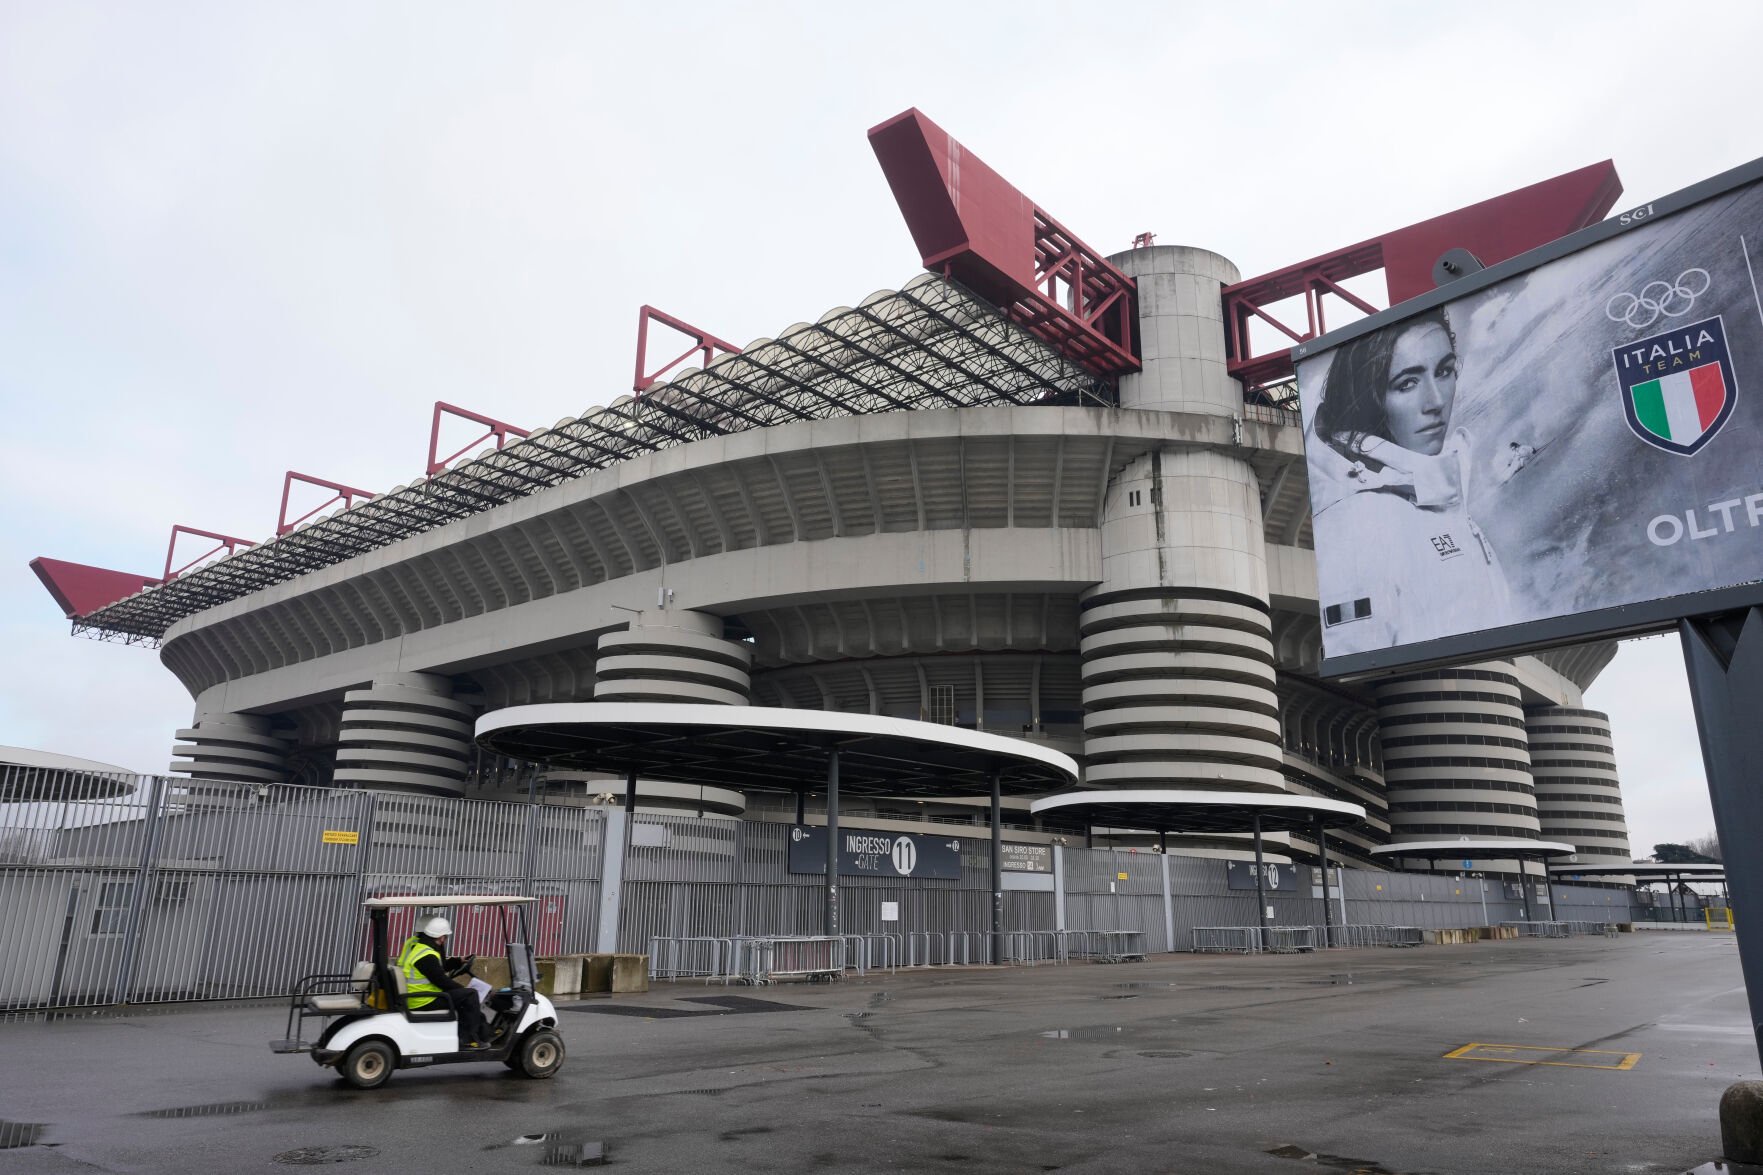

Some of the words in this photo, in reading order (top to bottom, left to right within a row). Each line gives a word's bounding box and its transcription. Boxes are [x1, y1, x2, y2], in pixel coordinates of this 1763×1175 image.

[1620, 204, 1654, 226] SCI
[1623, 329, 1714, 368] ITALIA
[1643, 351, 1701, 374] TEAM
[846, 835, 891, 855] INGRESSO
[895, 840, 912, 870] 11
[1001, 845, 1013, 853] SAN
[1014, 846, 1027, 854] SIRO
[1029, 847, 1046, 856] STORE
[858, 854, 879, 870] GATE
